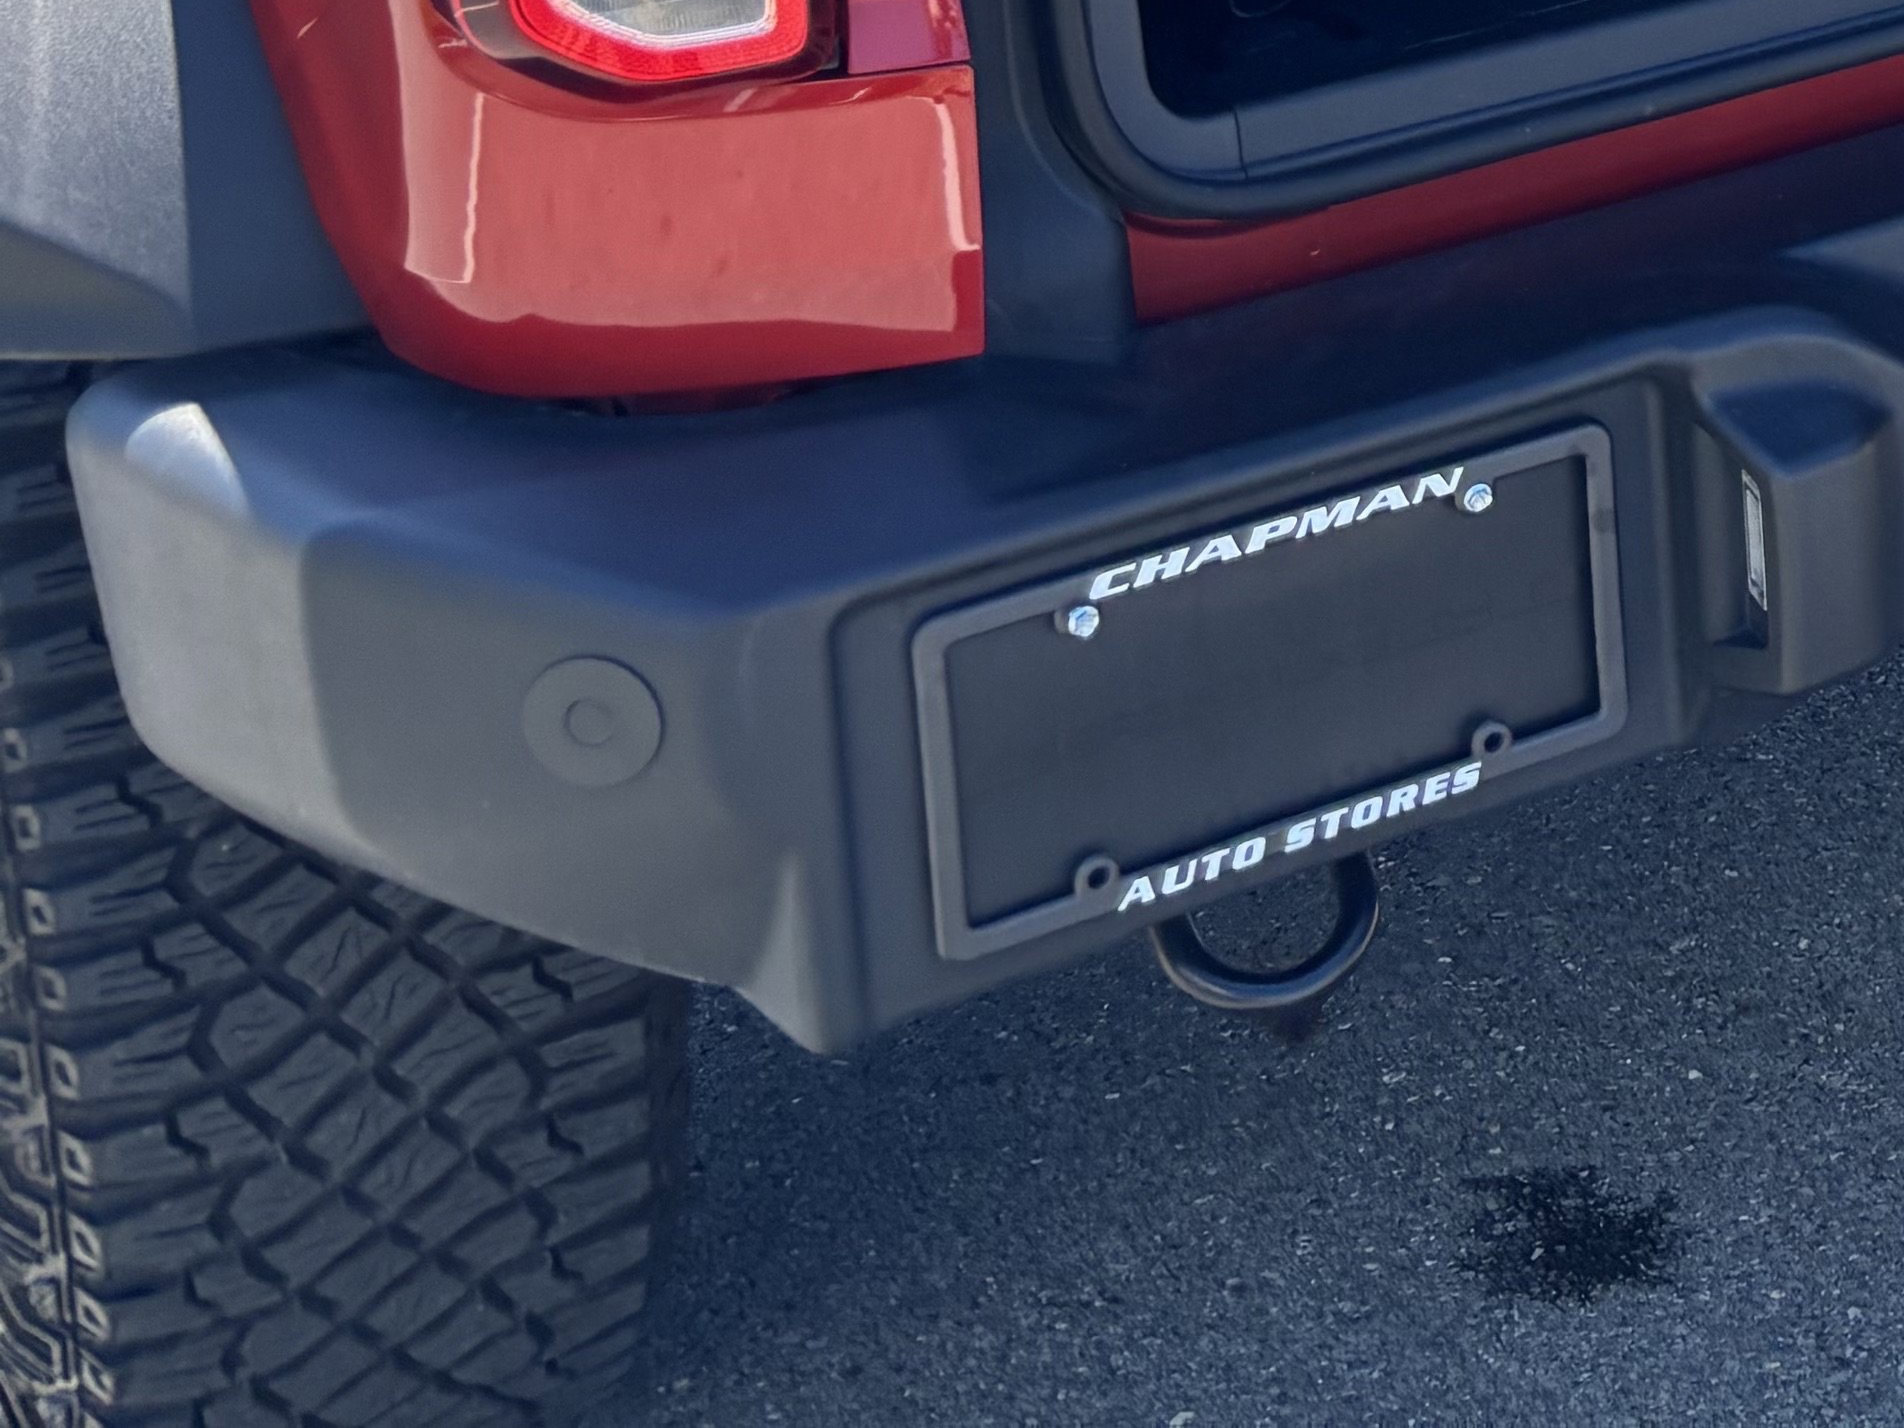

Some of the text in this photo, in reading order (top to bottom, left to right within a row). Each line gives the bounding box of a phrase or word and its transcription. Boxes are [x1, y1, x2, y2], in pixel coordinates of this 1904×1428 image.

[1089, 466, 1464, 600] CHAPMAN
[1117, 760, 1482, 912] AUTO STORES
